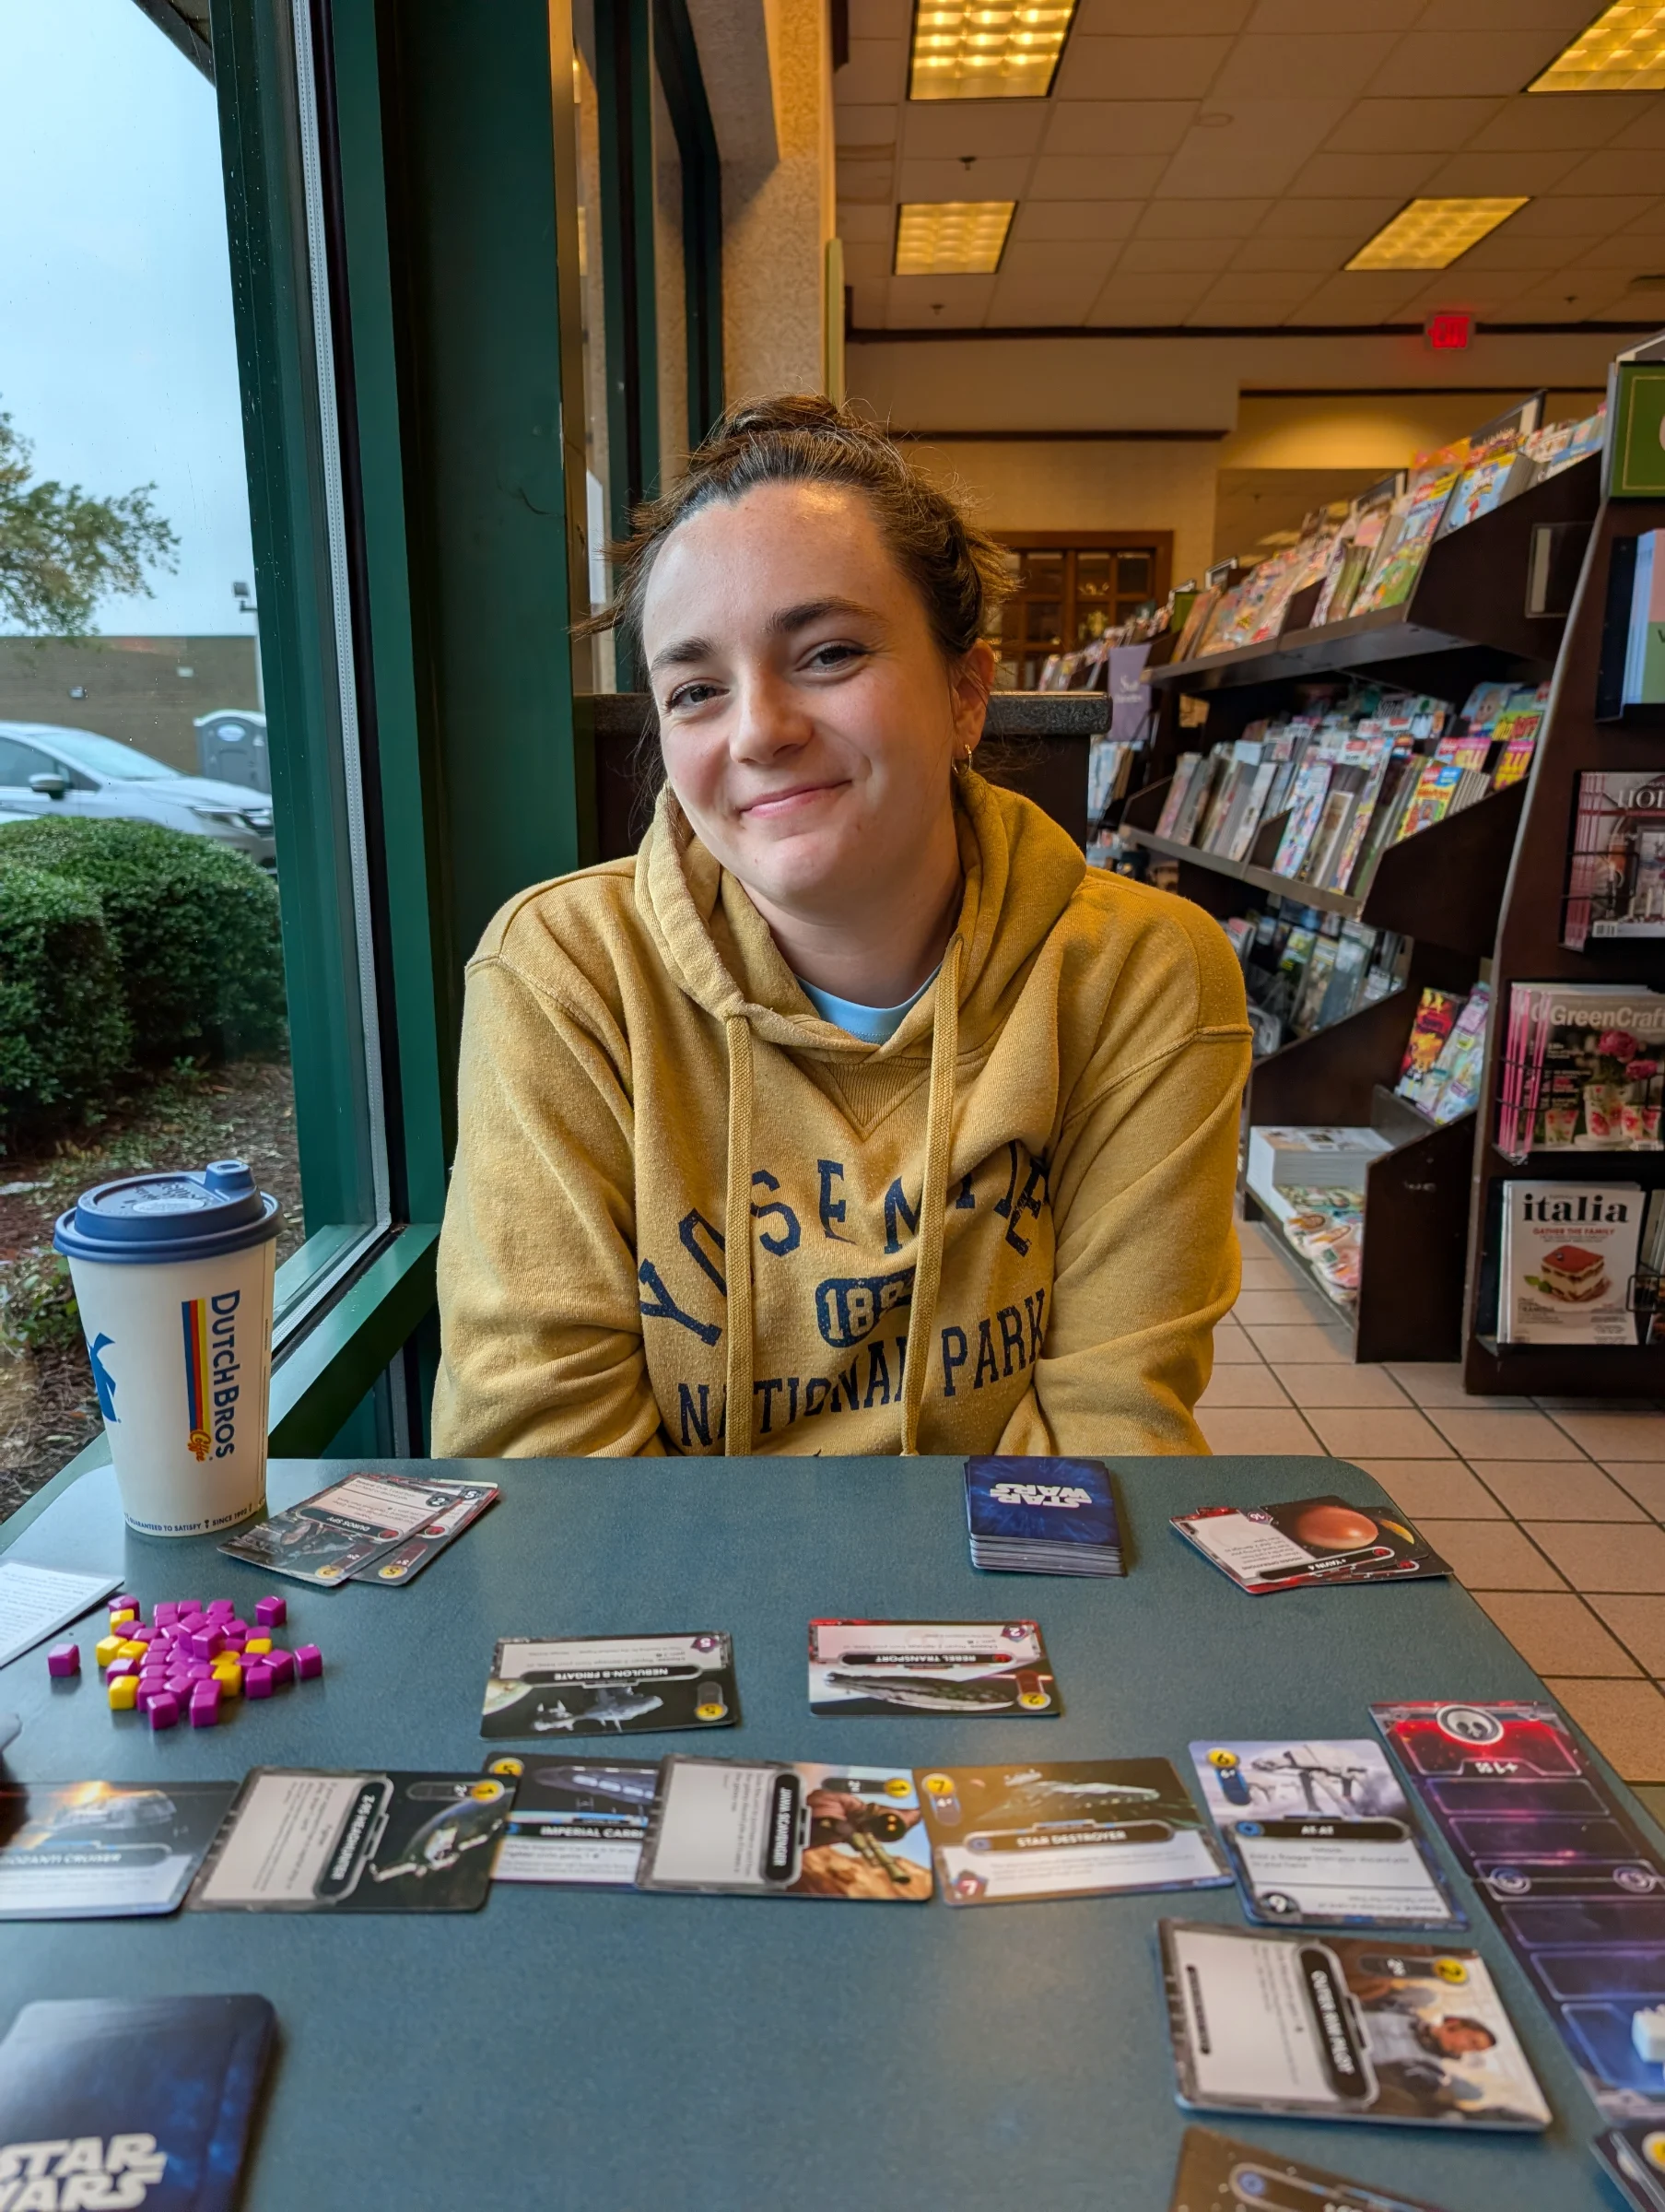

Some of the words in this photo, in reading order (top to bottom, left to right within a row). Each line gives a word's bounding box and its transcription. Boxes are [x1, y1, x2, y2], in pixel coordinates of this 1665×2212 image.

[1523, 1193, 1629, 1223] italia
[1567, 1227, 1582, 1236] THE
[677, 1335, 909, 1447] NTIONA
[941, 1287, 1046, 1397] PARK
[464, 1489, 477, 1500] 5
[991, 1483, 1090, 1499] WARS
[431, 1495, 446, 1507] 2
[991, 1493, 1092, 1509] STAR
[129, 1517, 163, 1532] GUARANTEED
[174, 1523, 202, 1532] SATISFY
[212, 1514, 233, 1526] SINCE
[326, 1516, 343, 1526] SPY
[342, 1519, 371, 1532] DUROS
[1009, 1627, 1022, 1637] 2
[874, 1654, 940, 1664] TRANSPORT
[942, 1654, 977, 1663] REBEL
[554, 1670, 600, 1681] FRIGATE
[602, 1666, 669, 1679] NEBULON-B
[1027, 1695, 1039, 1705] 2
[1216, 1752, 1230, 1765] 6
[932, 1780, 946, 1793] 7
[778, 1786, 792, 1813] JAWA
[539, 1825, 602, 1838] IMPERIAL
[773, 1812, 791, 1867] SCAVENGER
[1016, 1835, 1050, 1848] STAR
[1051, 1830, 1127, 1846] DESTROYER
[332, 1815, 367, 1881] HEADHUNTER
[64, 1852, 122, 1864] CRUISER
[962, 1879, 979, 1895] 7
[1439, 1964, 1460, 1978] 2
[1309, 1970, 1334, 2004] OUTER
[1327, 2035, 1355, 2075] PILOT
